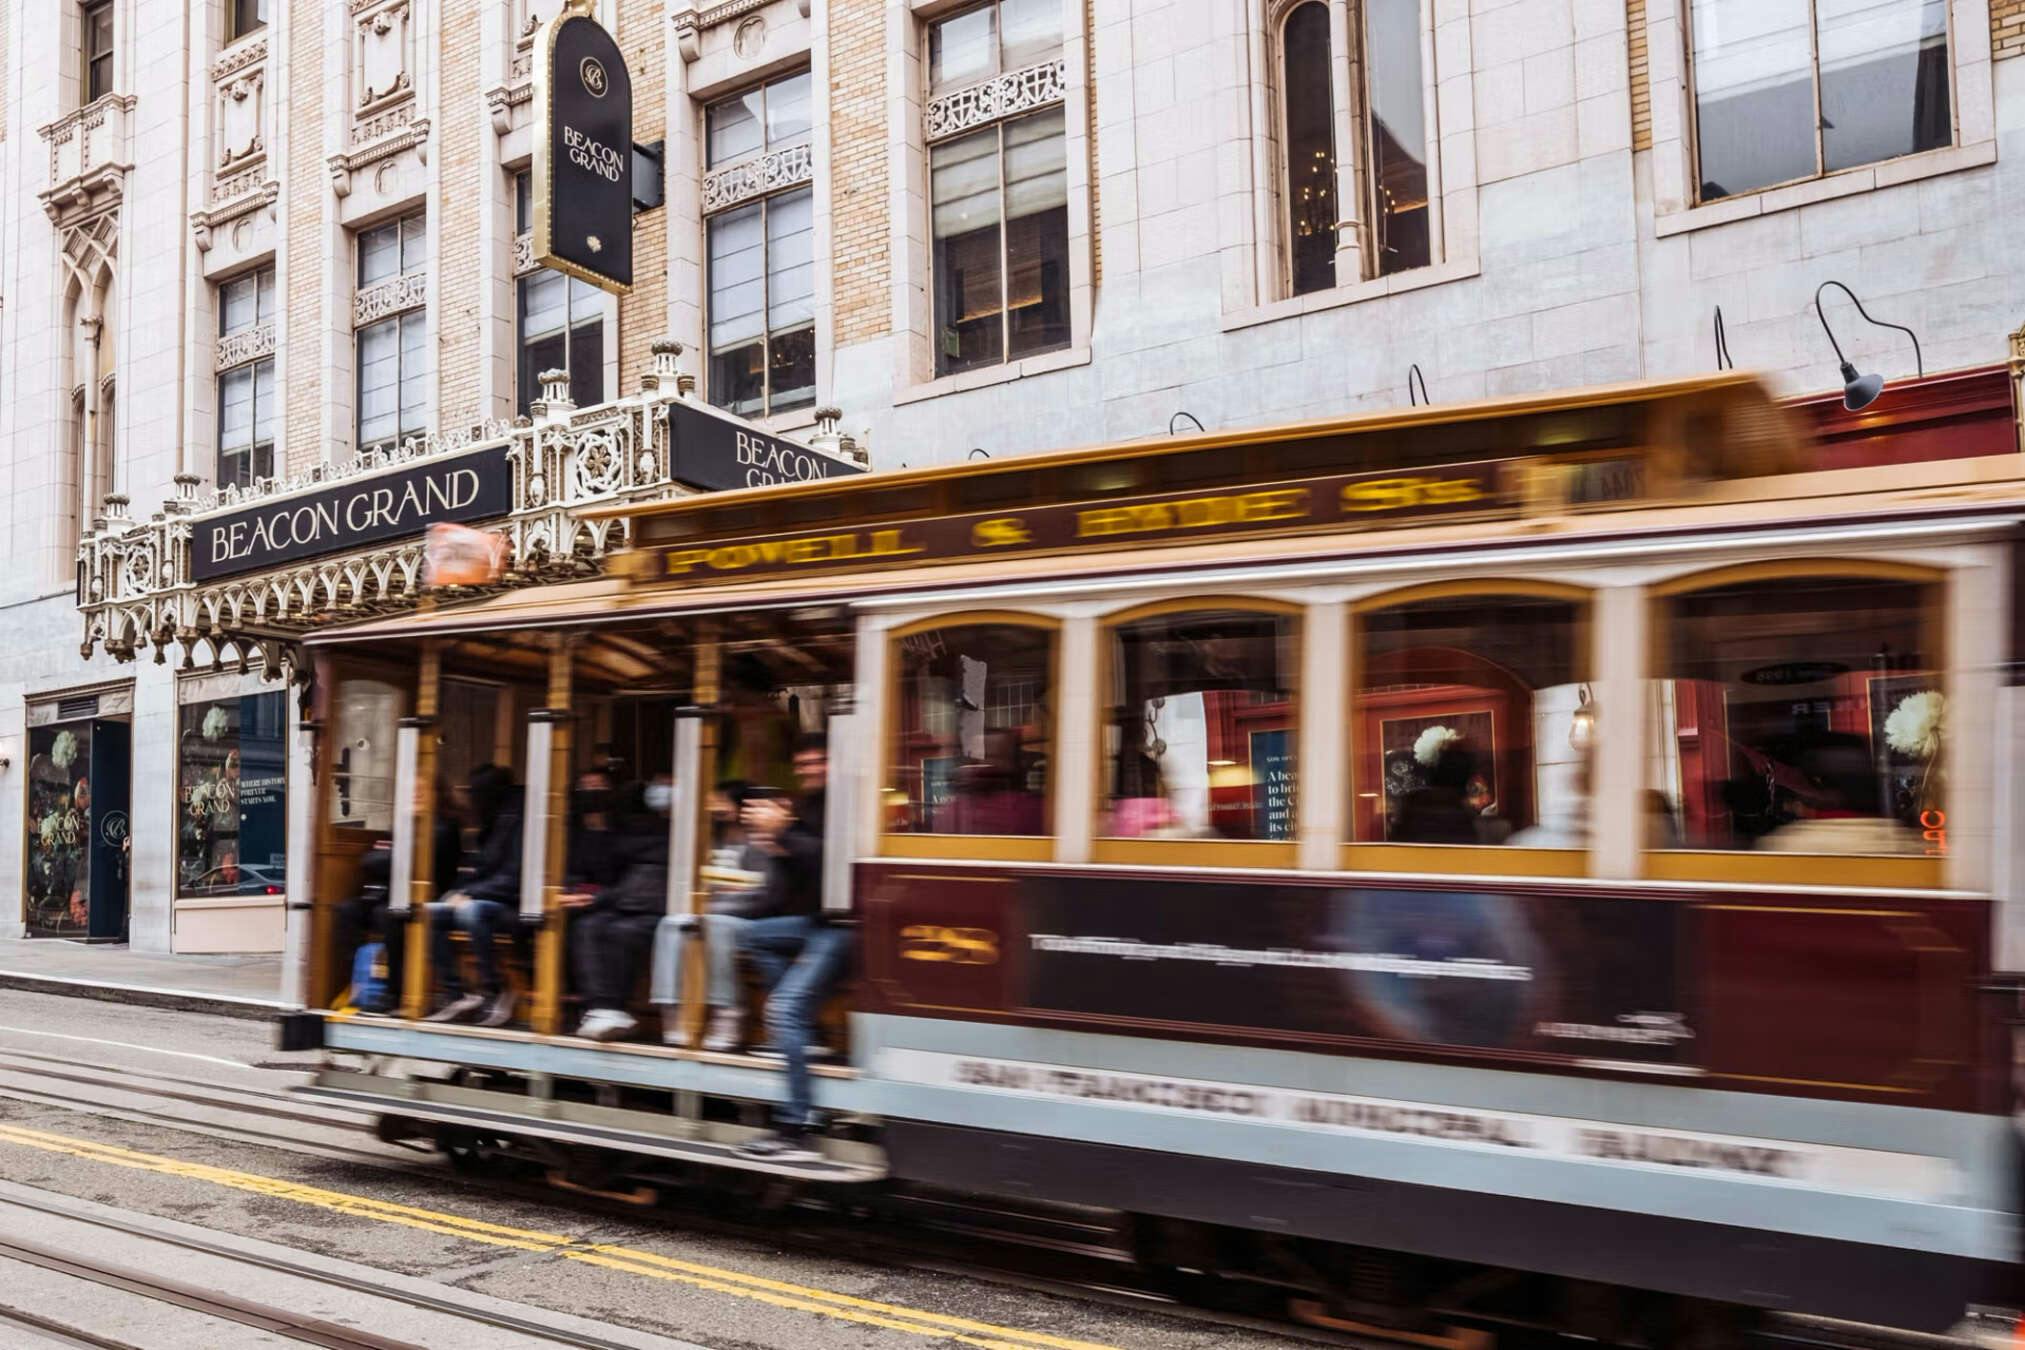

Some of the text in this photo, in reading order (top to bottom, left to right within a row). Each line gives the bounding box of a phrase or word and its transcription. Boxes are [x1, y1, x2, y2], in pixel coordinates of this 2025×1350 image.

[564, 125, 624, 172] BEACON
[569, 147, 620, 182] GRAND
[735, 431, 827, 482] BEACON
[211, 468, 481, 563] BEACON GRAND
[666, 528, 926, 576] POWELL
[1268, 785, 1279, 795] to
[1268, 797, 1286, 808] the
[1269, 808, 1290, 821] and
[1269, 822, 1283, 833] its
